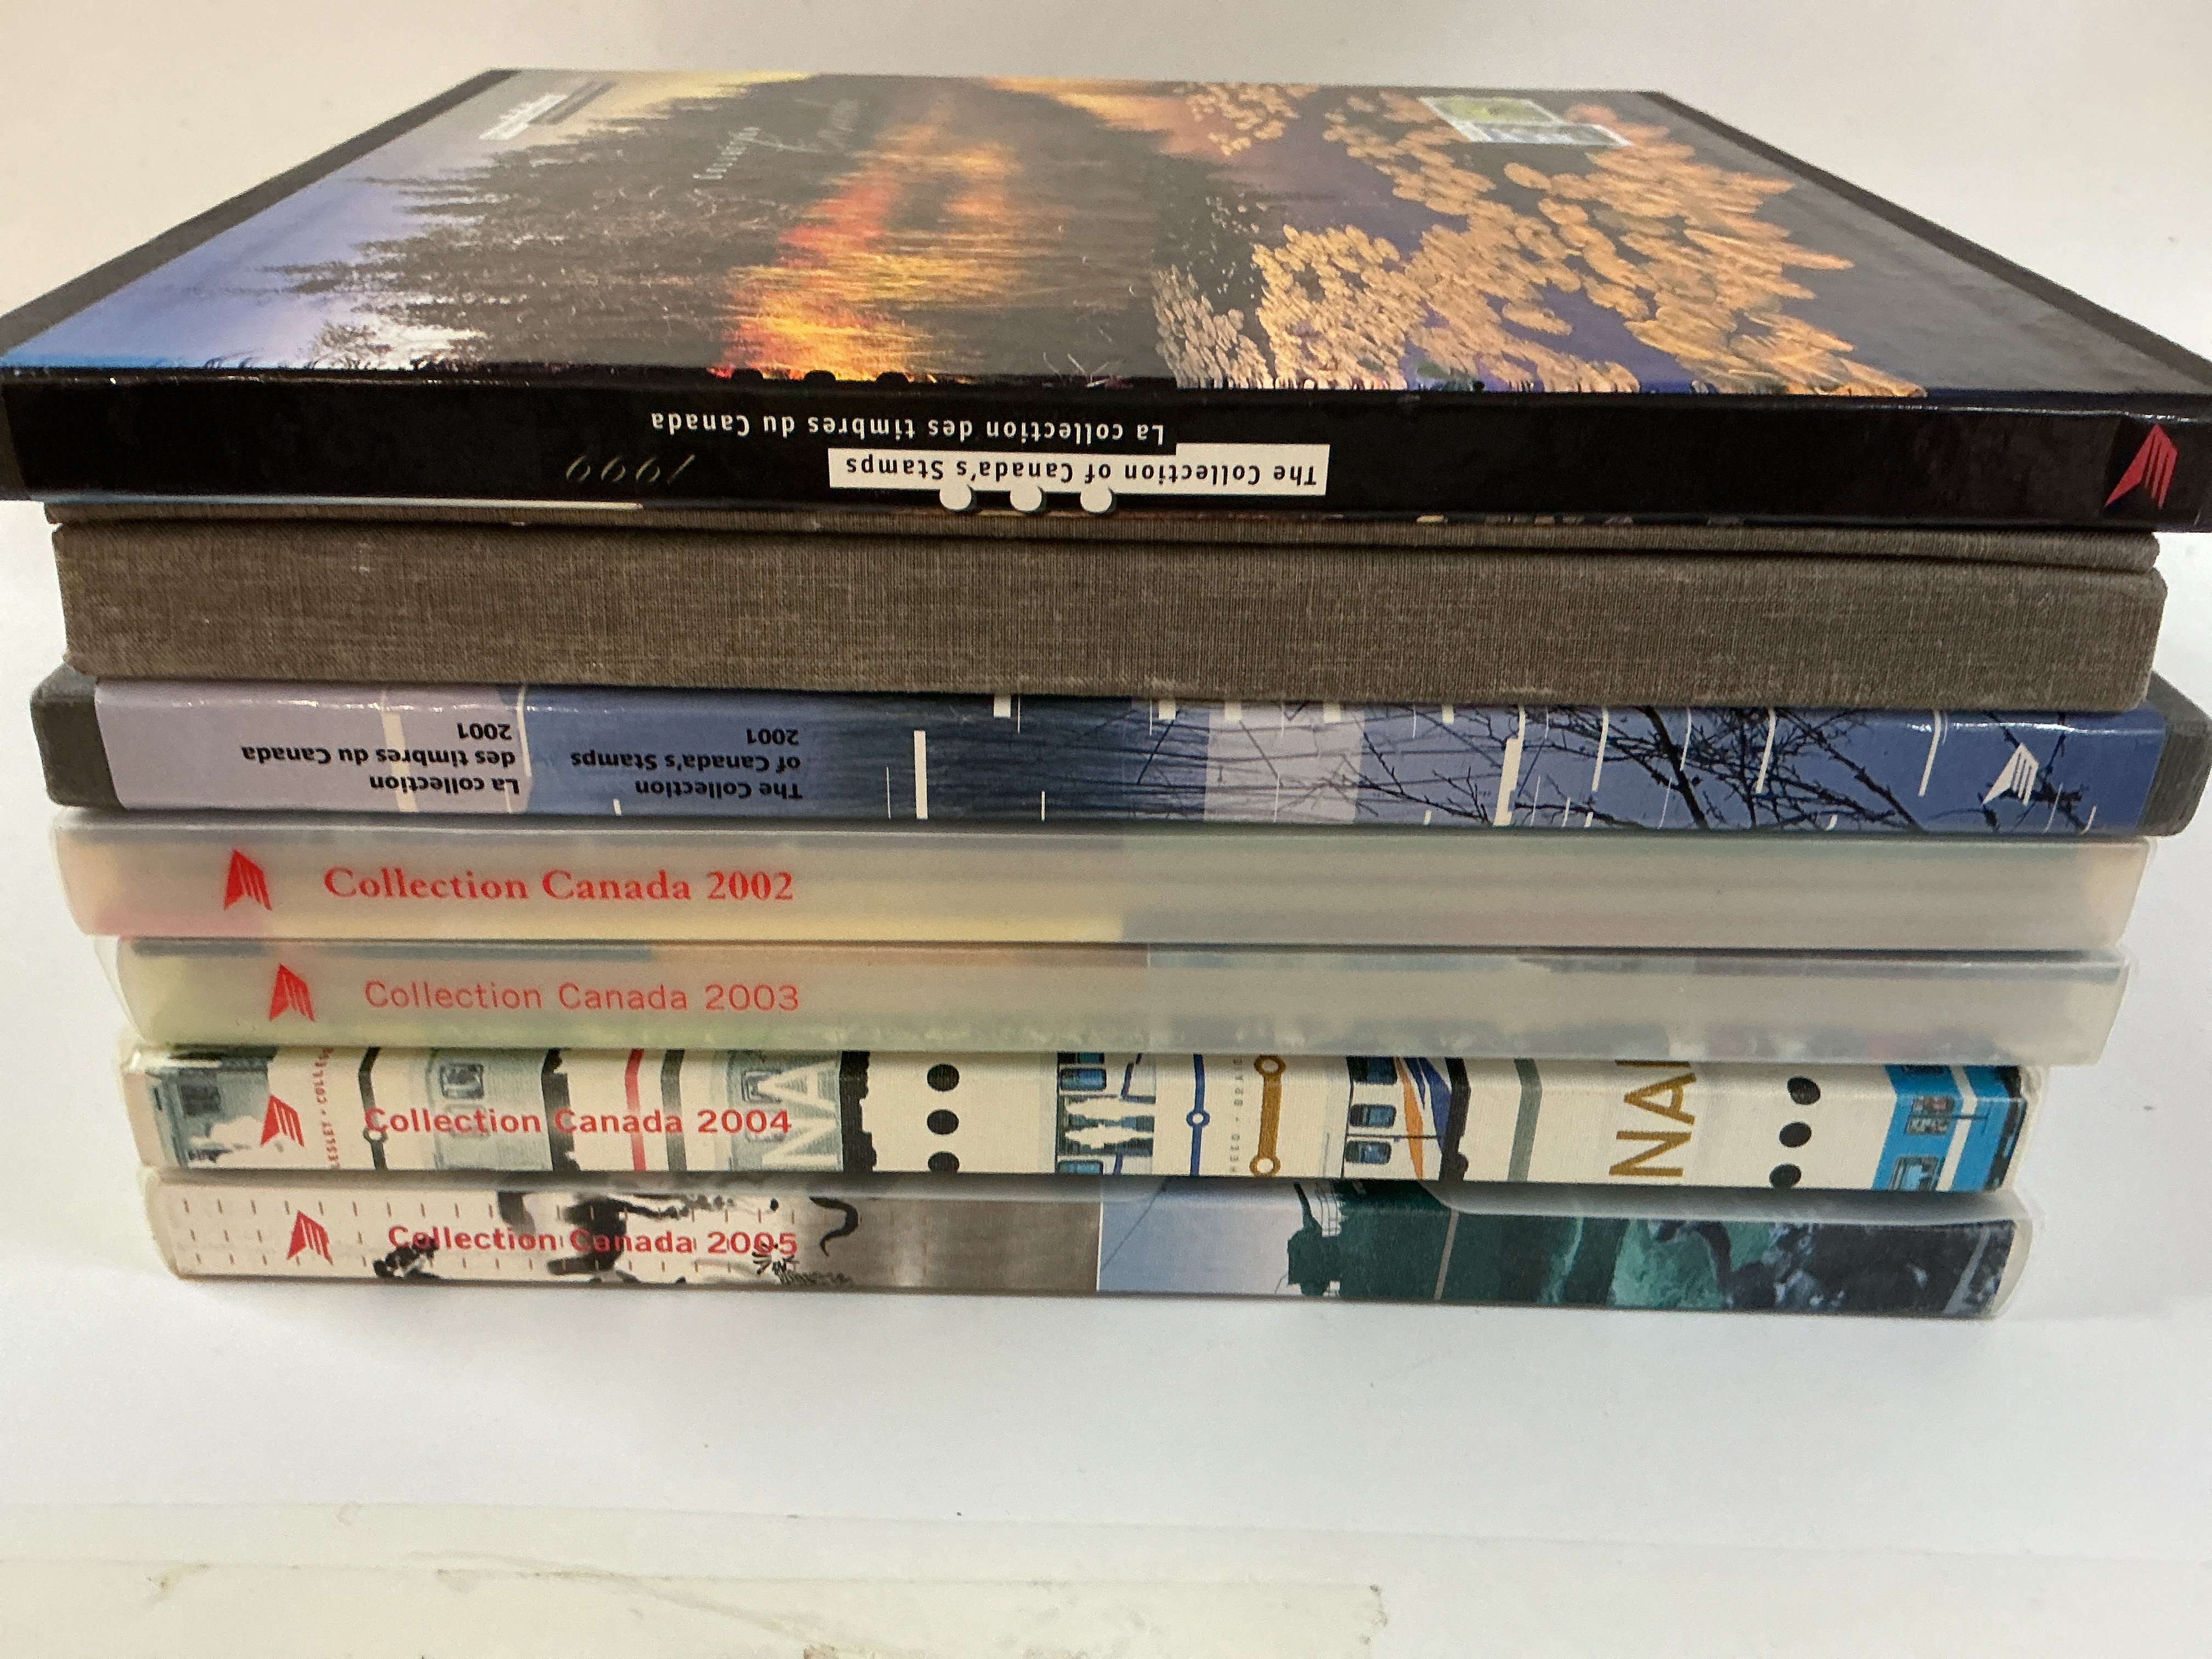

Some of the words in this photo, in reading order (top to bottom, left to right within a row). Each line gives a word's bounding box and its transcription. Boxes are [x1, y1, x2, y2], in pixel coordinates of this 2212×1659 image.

[652, 413, 750, 436] Canada
[764, 415, 794, 438] du
[809, 416, 915, 441] timbres
[929, 418, 973, 442] des
[987, 421, 1123, 446] collection
[1138, 425, 1164, 445] La
[566, 454, 695, 484] 1999
[847, 454, 943, 479] Stamps
[956, 460, 1073, 483] Canada's
[1084, 462, 1111, 484] of
[1125, 464, 1260, 485] Collection
[1273, 465, 1317, 486] The
[456, 723, 512, 740] 2001
[746, 728, 799, 745] 2001
[241, 746, 331, 764] Canada
[338, 748, 368, 765] du
[376, 748, 468, 767] timbres
[475, 750, 515, 768] des
[571, 749, 657, 770] Stamps
[665, 753, 769, 772] Canada's
[775, 755, 800, 773] of
[370, 775, 485, 794] collection
[493, 777, 520, 795] La
[636, 780, 752, 799] Collection
[759, 781, 803, 799] The
[323, 866, 528, 899] Collection
[542, 868, 691, 900] Canada
[707, 870, 794, 901] 2002
[365, 980, 542, 1009] Collection
[558, 982, 687, 1011] Canada
[705, 984, 799, 1012] 2003
[365, 1108, 540, 1133] Collection
[554, 1108, 682, 1134] Canada
[697, 1109, 792, 1135] 2004
[388, 1224, 557, 1251] Collection
[571, 1228, 692, 1254] Canada
[707, 1231, 797, 1255] 2005
